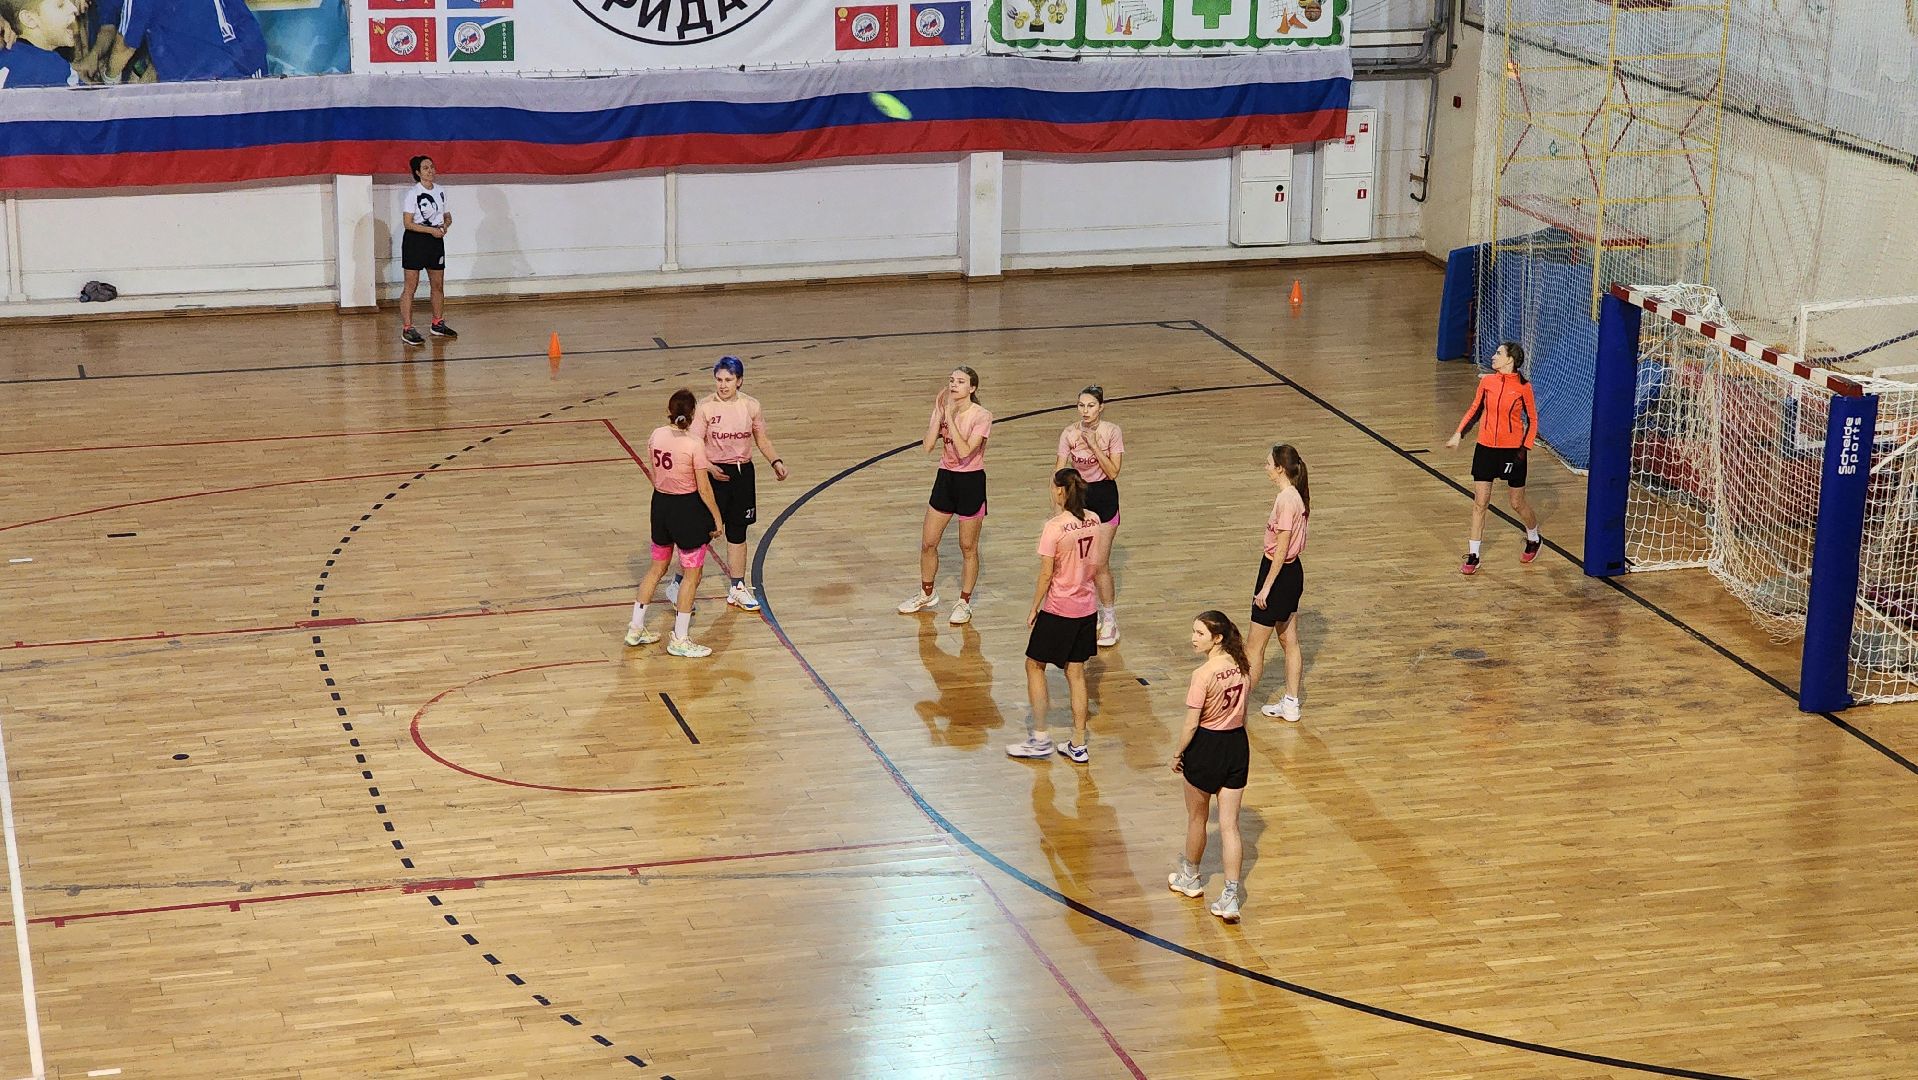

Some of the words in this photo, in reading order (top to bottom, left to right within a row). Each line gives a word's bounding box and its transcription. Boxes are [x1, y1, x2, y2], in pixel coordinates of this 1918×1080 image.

[711, 415, 722, 425] 27
[1838, 417, 1854, 475] Schelde
[1847, 417, 1862, 475] Sports
[653, 449, 673, 471] 56
[1077, 535, 1094, 559] 17
[1222, 683, 1243, 711] 57
